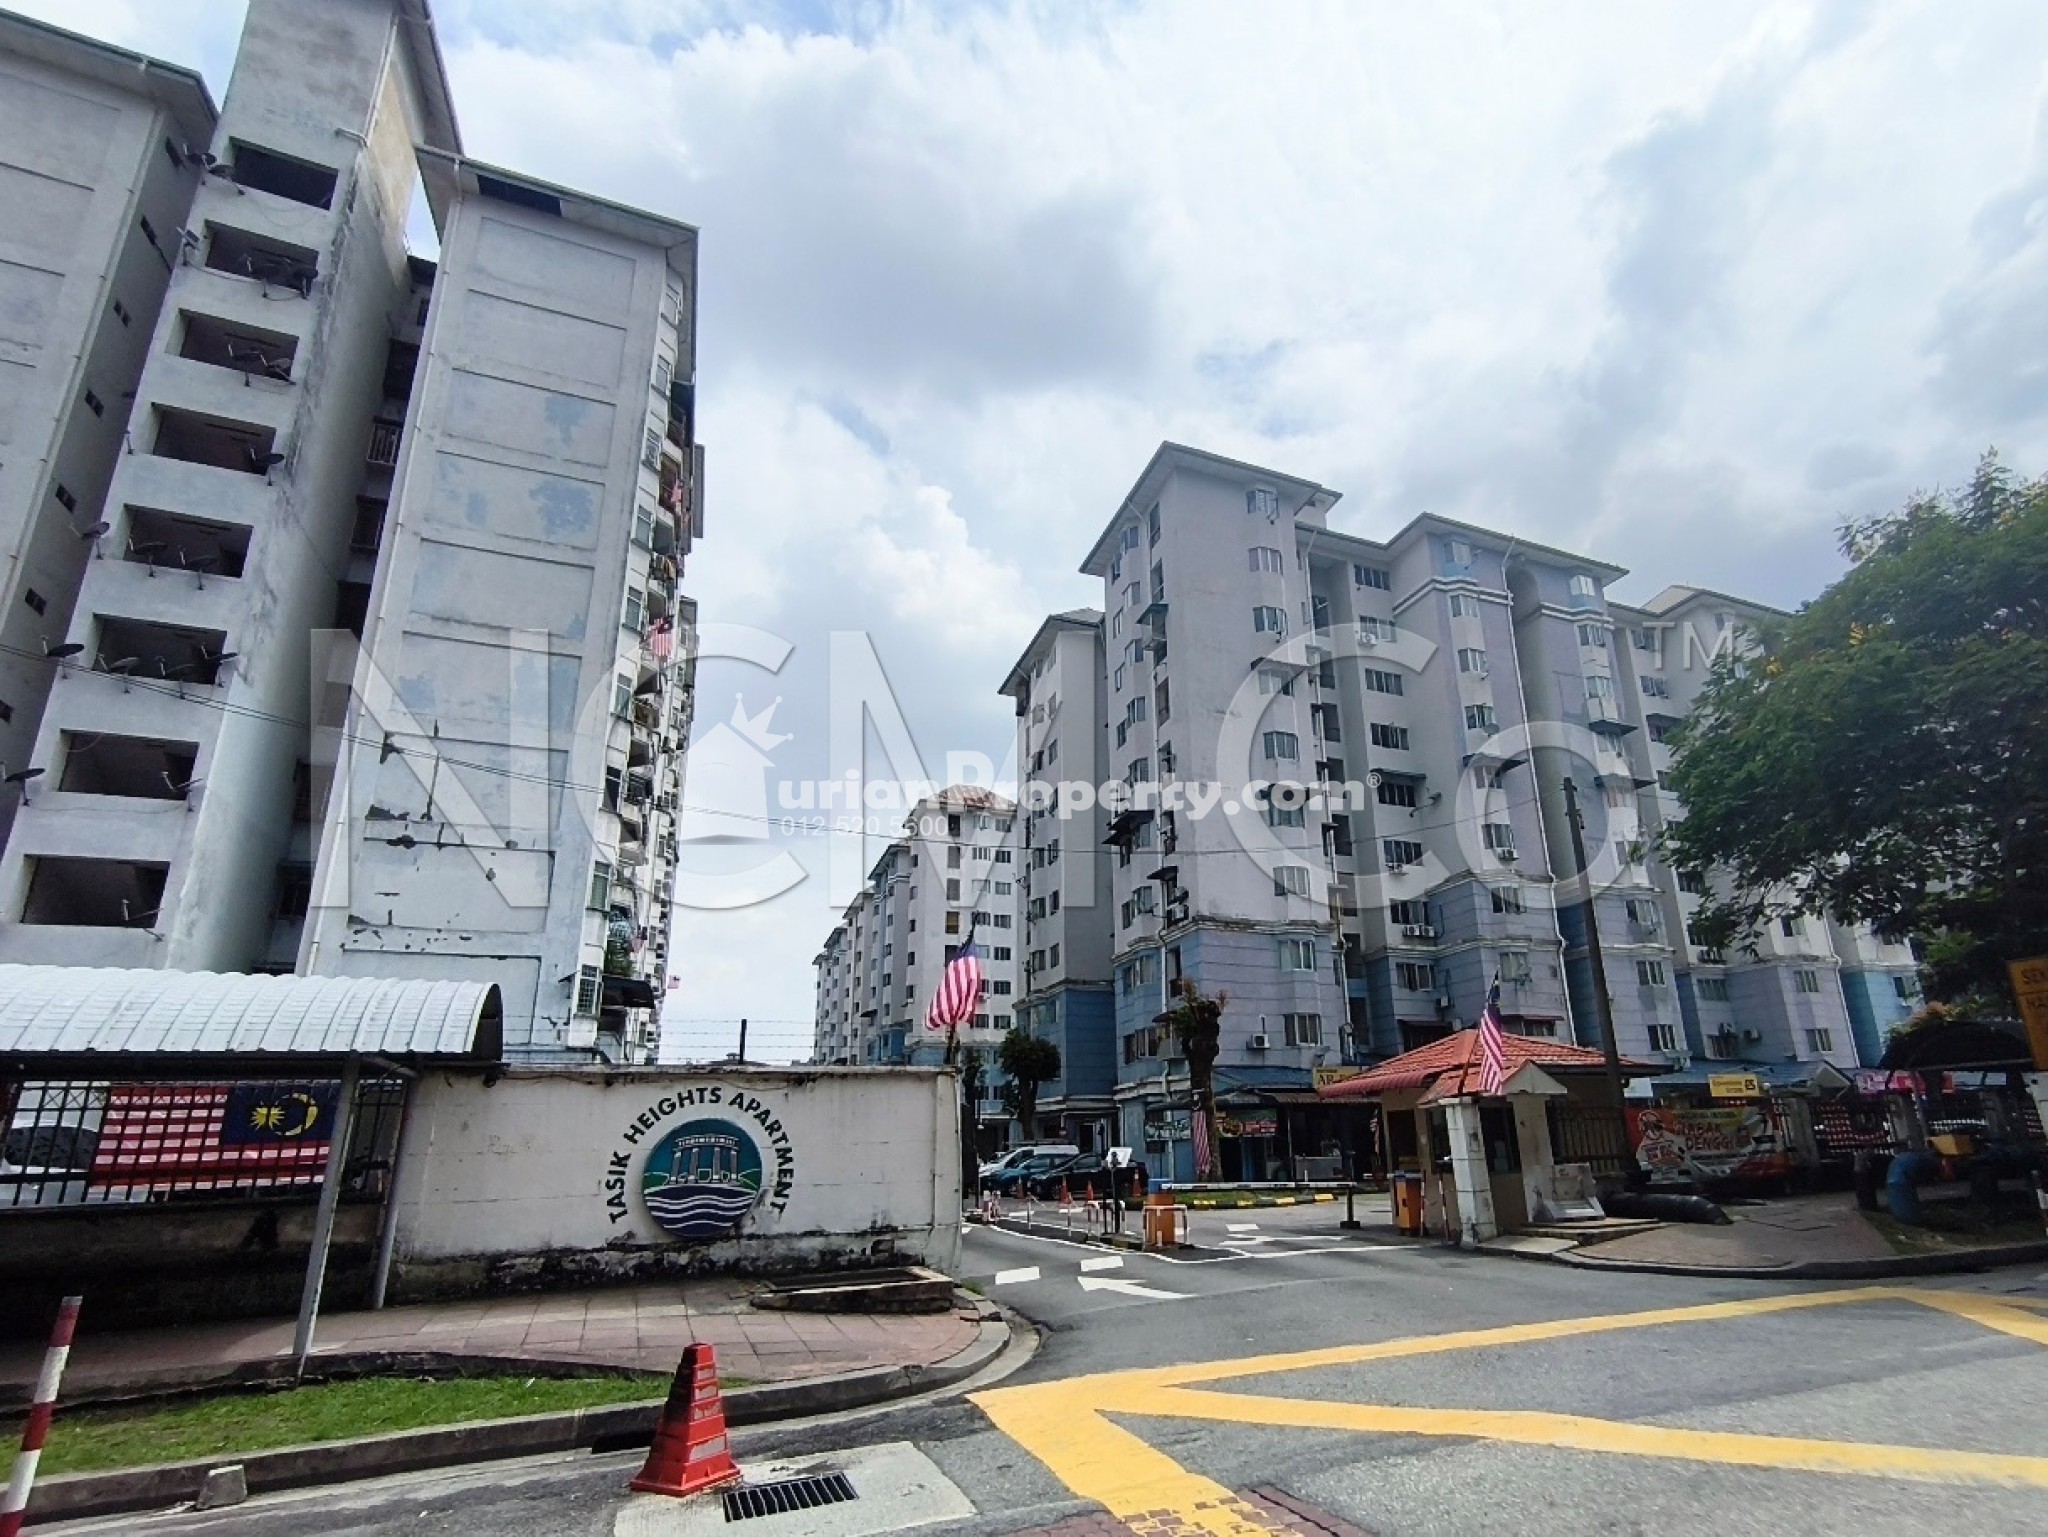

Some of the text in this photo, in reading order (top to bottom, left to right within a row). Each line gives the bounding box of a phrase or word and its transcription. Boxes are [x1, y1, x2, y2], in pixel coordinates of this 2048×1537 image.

[605, 1087, 794, 1224] TASIK HEIGHTS APARTMENT
